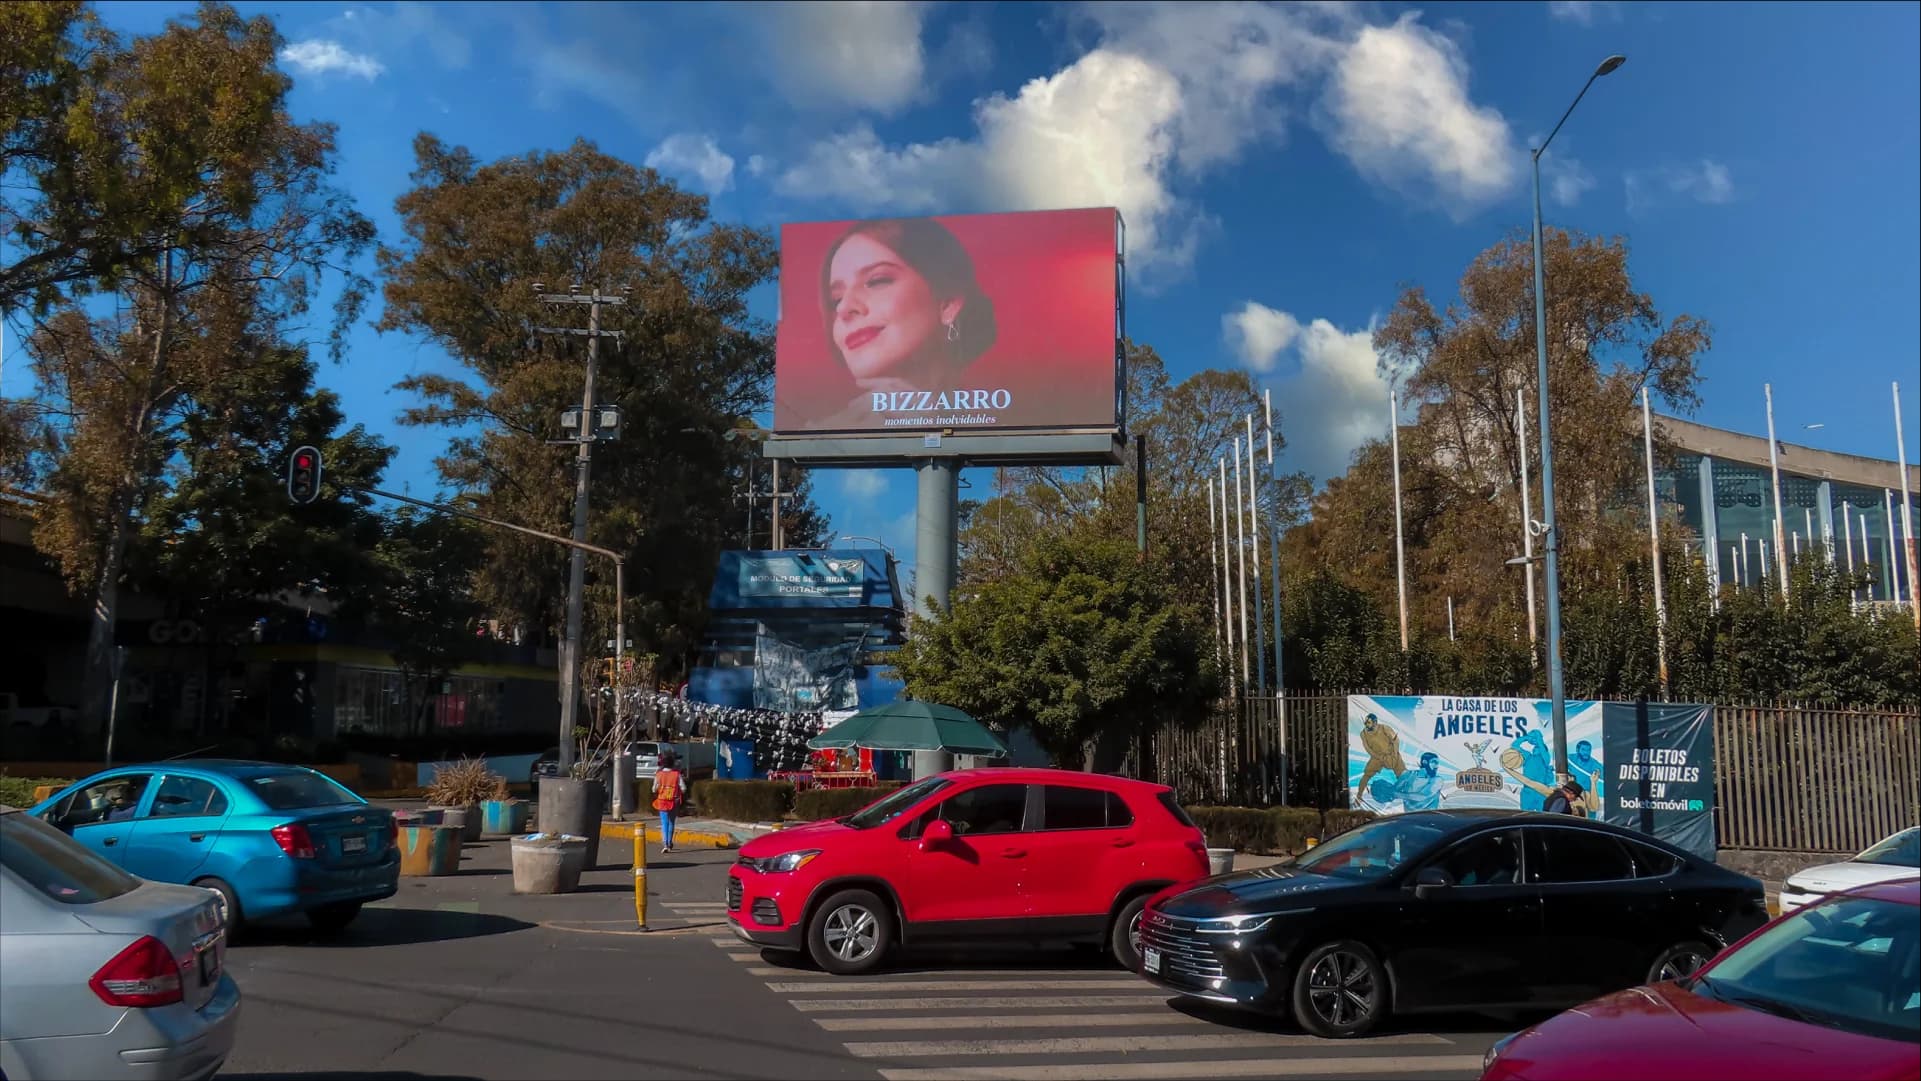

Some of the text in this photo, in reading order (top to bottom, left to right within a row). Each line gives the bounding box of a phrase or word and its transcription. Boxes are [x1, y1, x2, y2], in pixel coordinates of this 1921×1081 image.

[871, 388, 1012, 412] BIZZARRO
[884, 413, 997, 426] momentos inolvidables
[789, 575, 801, 583] DE
[802, 575, 852, 583] SEGURIDAD
[779, 585, 829, 593] PORTALES
[1442, 699, 1518, 713] LA CASA DE LOS
[1433, 712, 1529, 740] ÁNGELES
[1632, 748, 1687, 765] BOLETOS
[1619, 765, 1699, 782] DISPONIBLES
[1650, 783, 1666, 798] EN
[1620, 796, 1688, 811] boletomóvil
